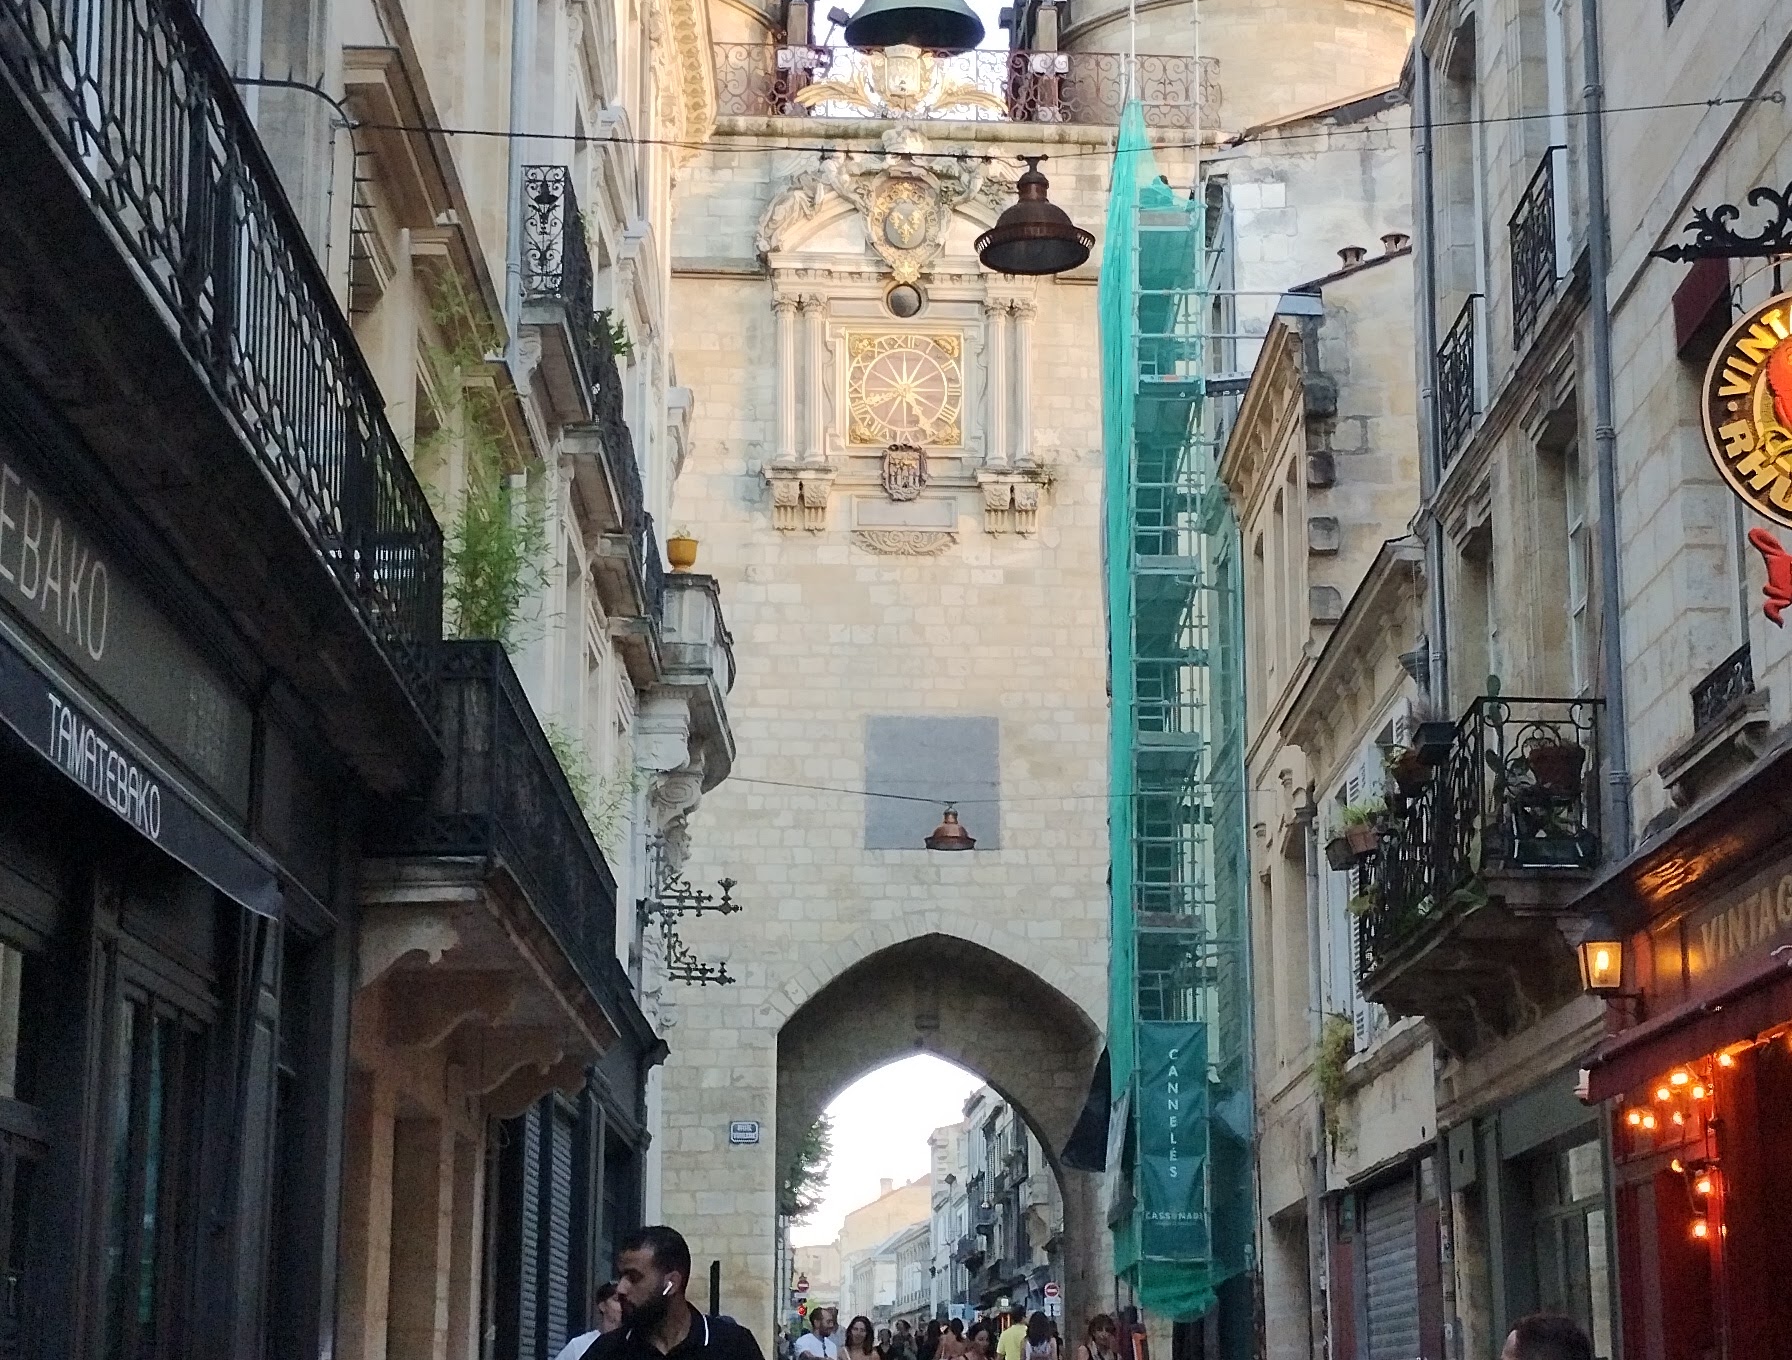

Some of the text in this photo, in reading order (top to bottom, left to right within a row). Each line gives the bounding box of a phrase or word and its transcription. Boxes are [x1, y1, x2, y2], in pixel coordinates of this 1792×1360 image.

[1718, 305, 1792, 397] VINT
[48, 692, 161, 839] TAMATEBAKO
[1167, 1048, 1179, 1178] CANNELÉS
